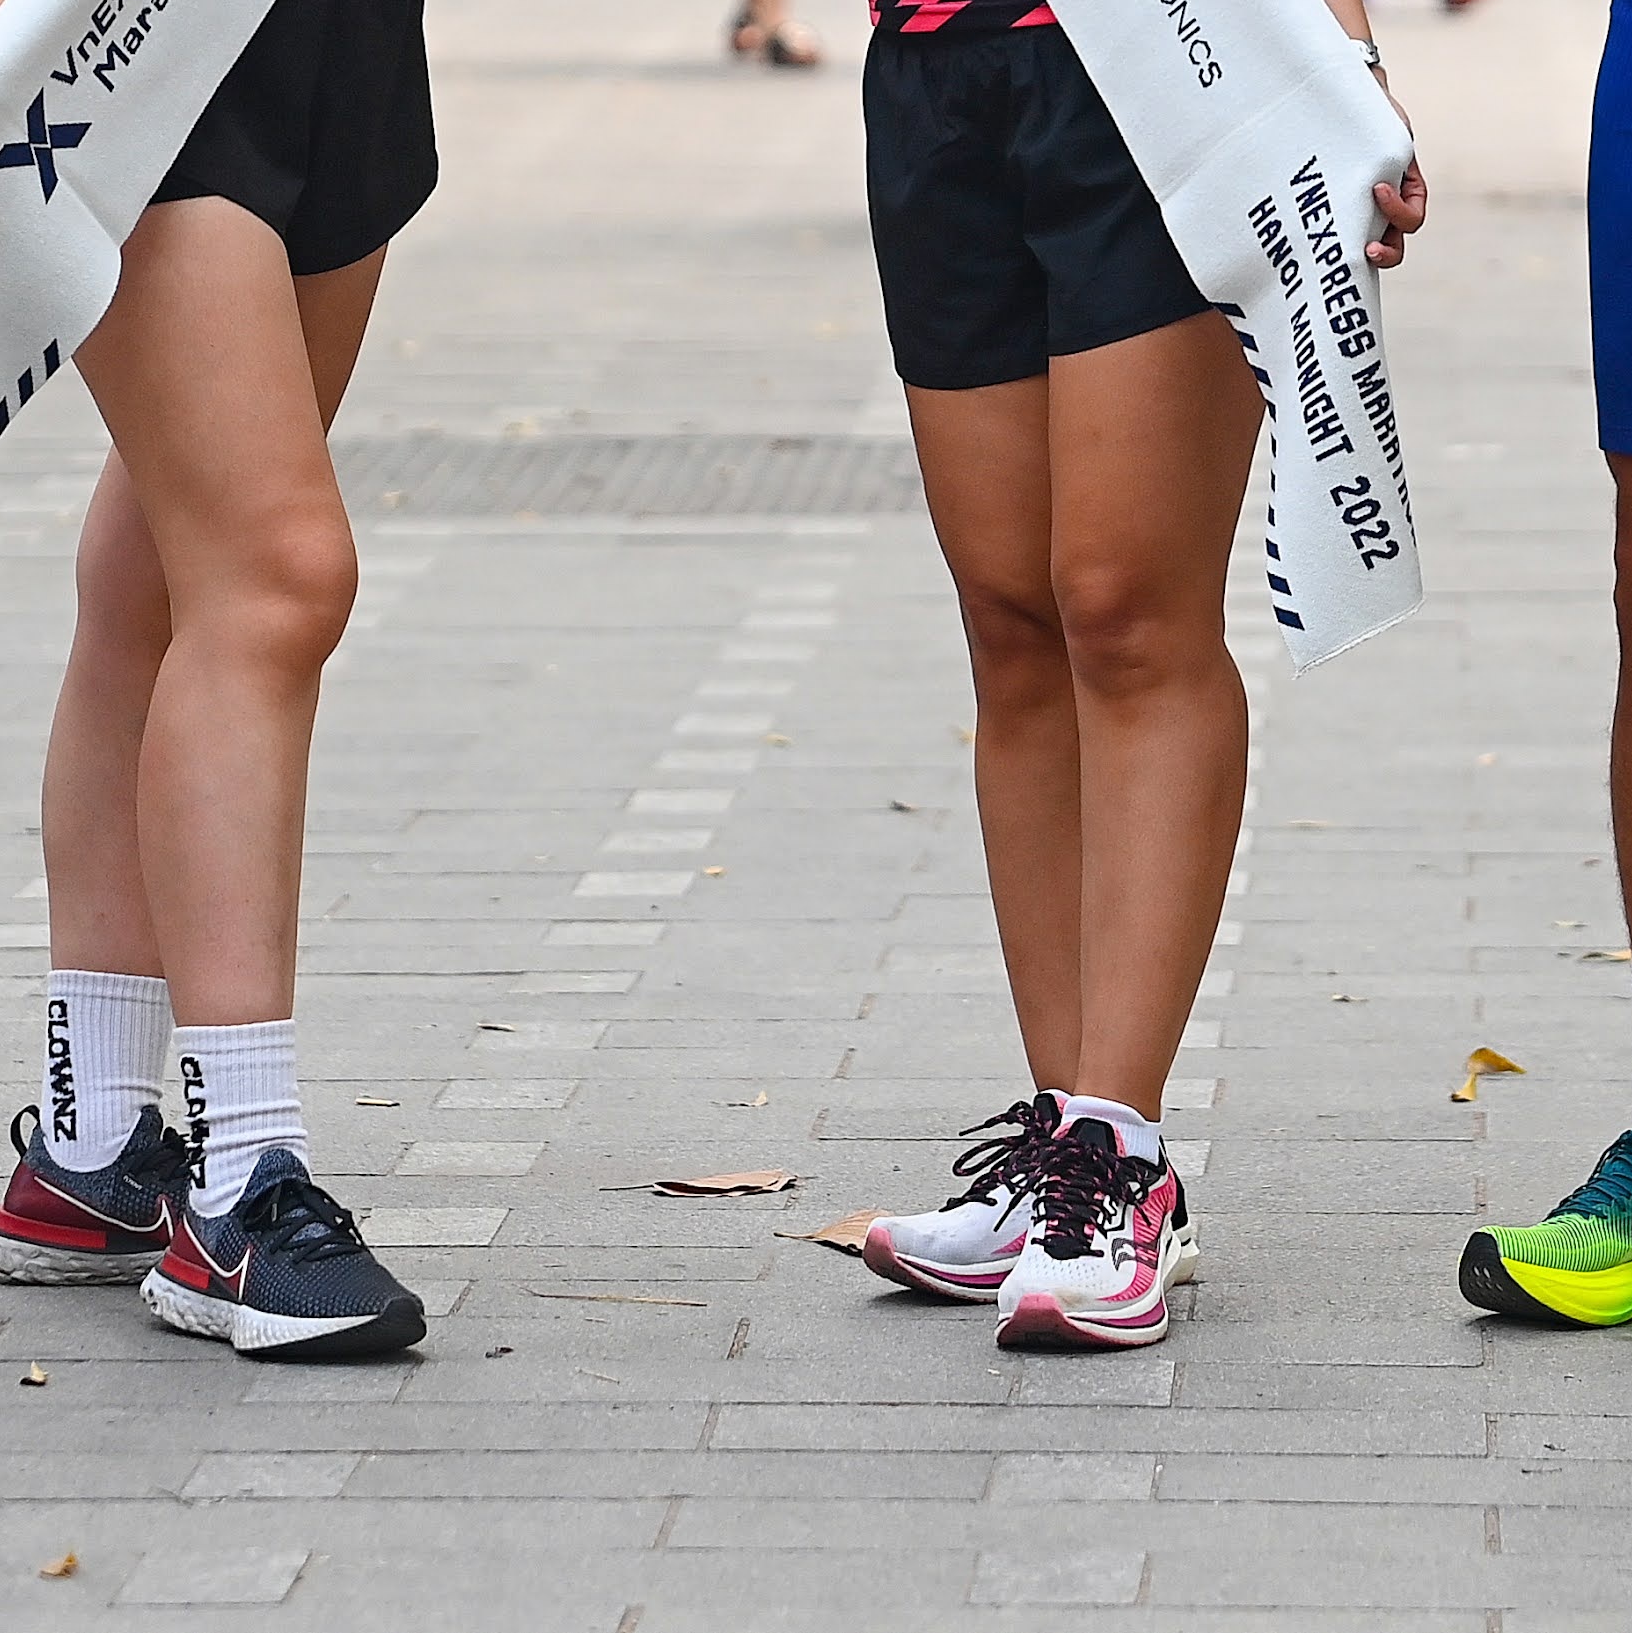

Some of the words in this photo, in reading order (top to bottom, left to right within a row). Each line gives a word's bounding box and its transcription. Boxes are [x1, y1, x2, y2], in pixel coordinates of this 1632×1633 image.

[1248, 195, 1304, 302] HANOI
[1290, 301, 1355, 463] MIDNIGHT
[1329, 475, 1400, 571] 2022
[1289, 155, 1373, 358] VNEXPRESS
